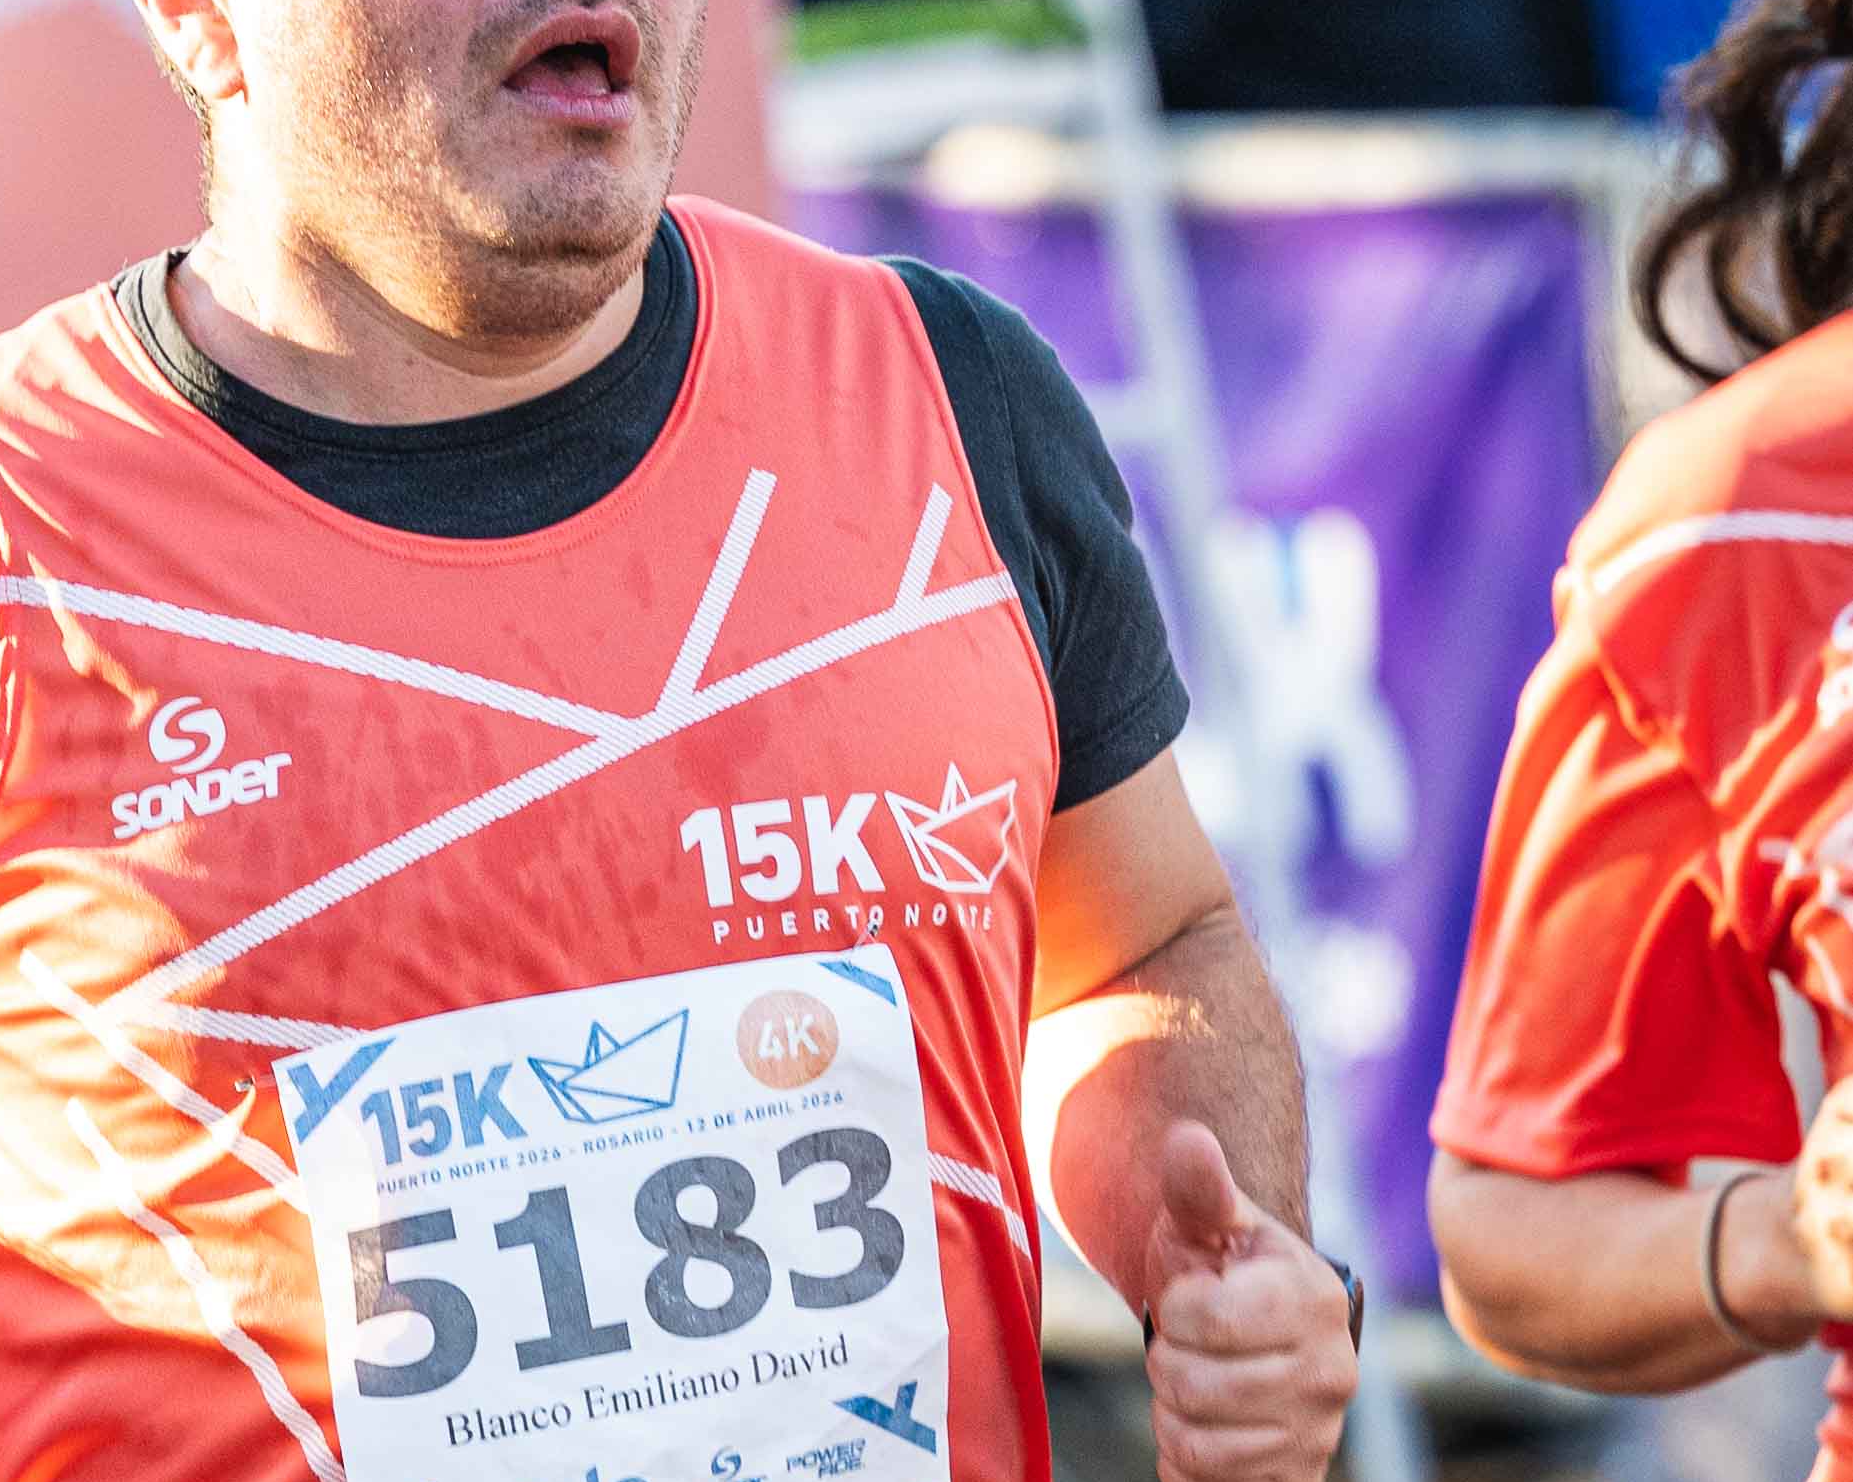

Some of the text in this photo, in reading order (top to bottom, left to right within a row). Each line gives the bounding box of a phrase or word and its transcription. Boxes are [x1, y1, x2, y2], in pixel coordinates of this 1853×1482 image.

[679, 792, 886, 909] 15K
[712, 904, 885, 945] PUERTO
[757, 1014, 820, 1061] 4K
[359, 1062, 528, 1167] 15K
[376, 1170, 442, 1197] PUERTO
[449, 1156, 509, 1181] NORTE
[583, 1127, 664, 1155] ROSARIO
[687, 1120, 706, 1134] 12
[714, 1113, 735, 1129] DE
[746, 1101, 795, 1122] ABRIL
[347, 1127, 905, 1399] 5183
[446, 1333, 850, 1447] Blanco Emiliano David
